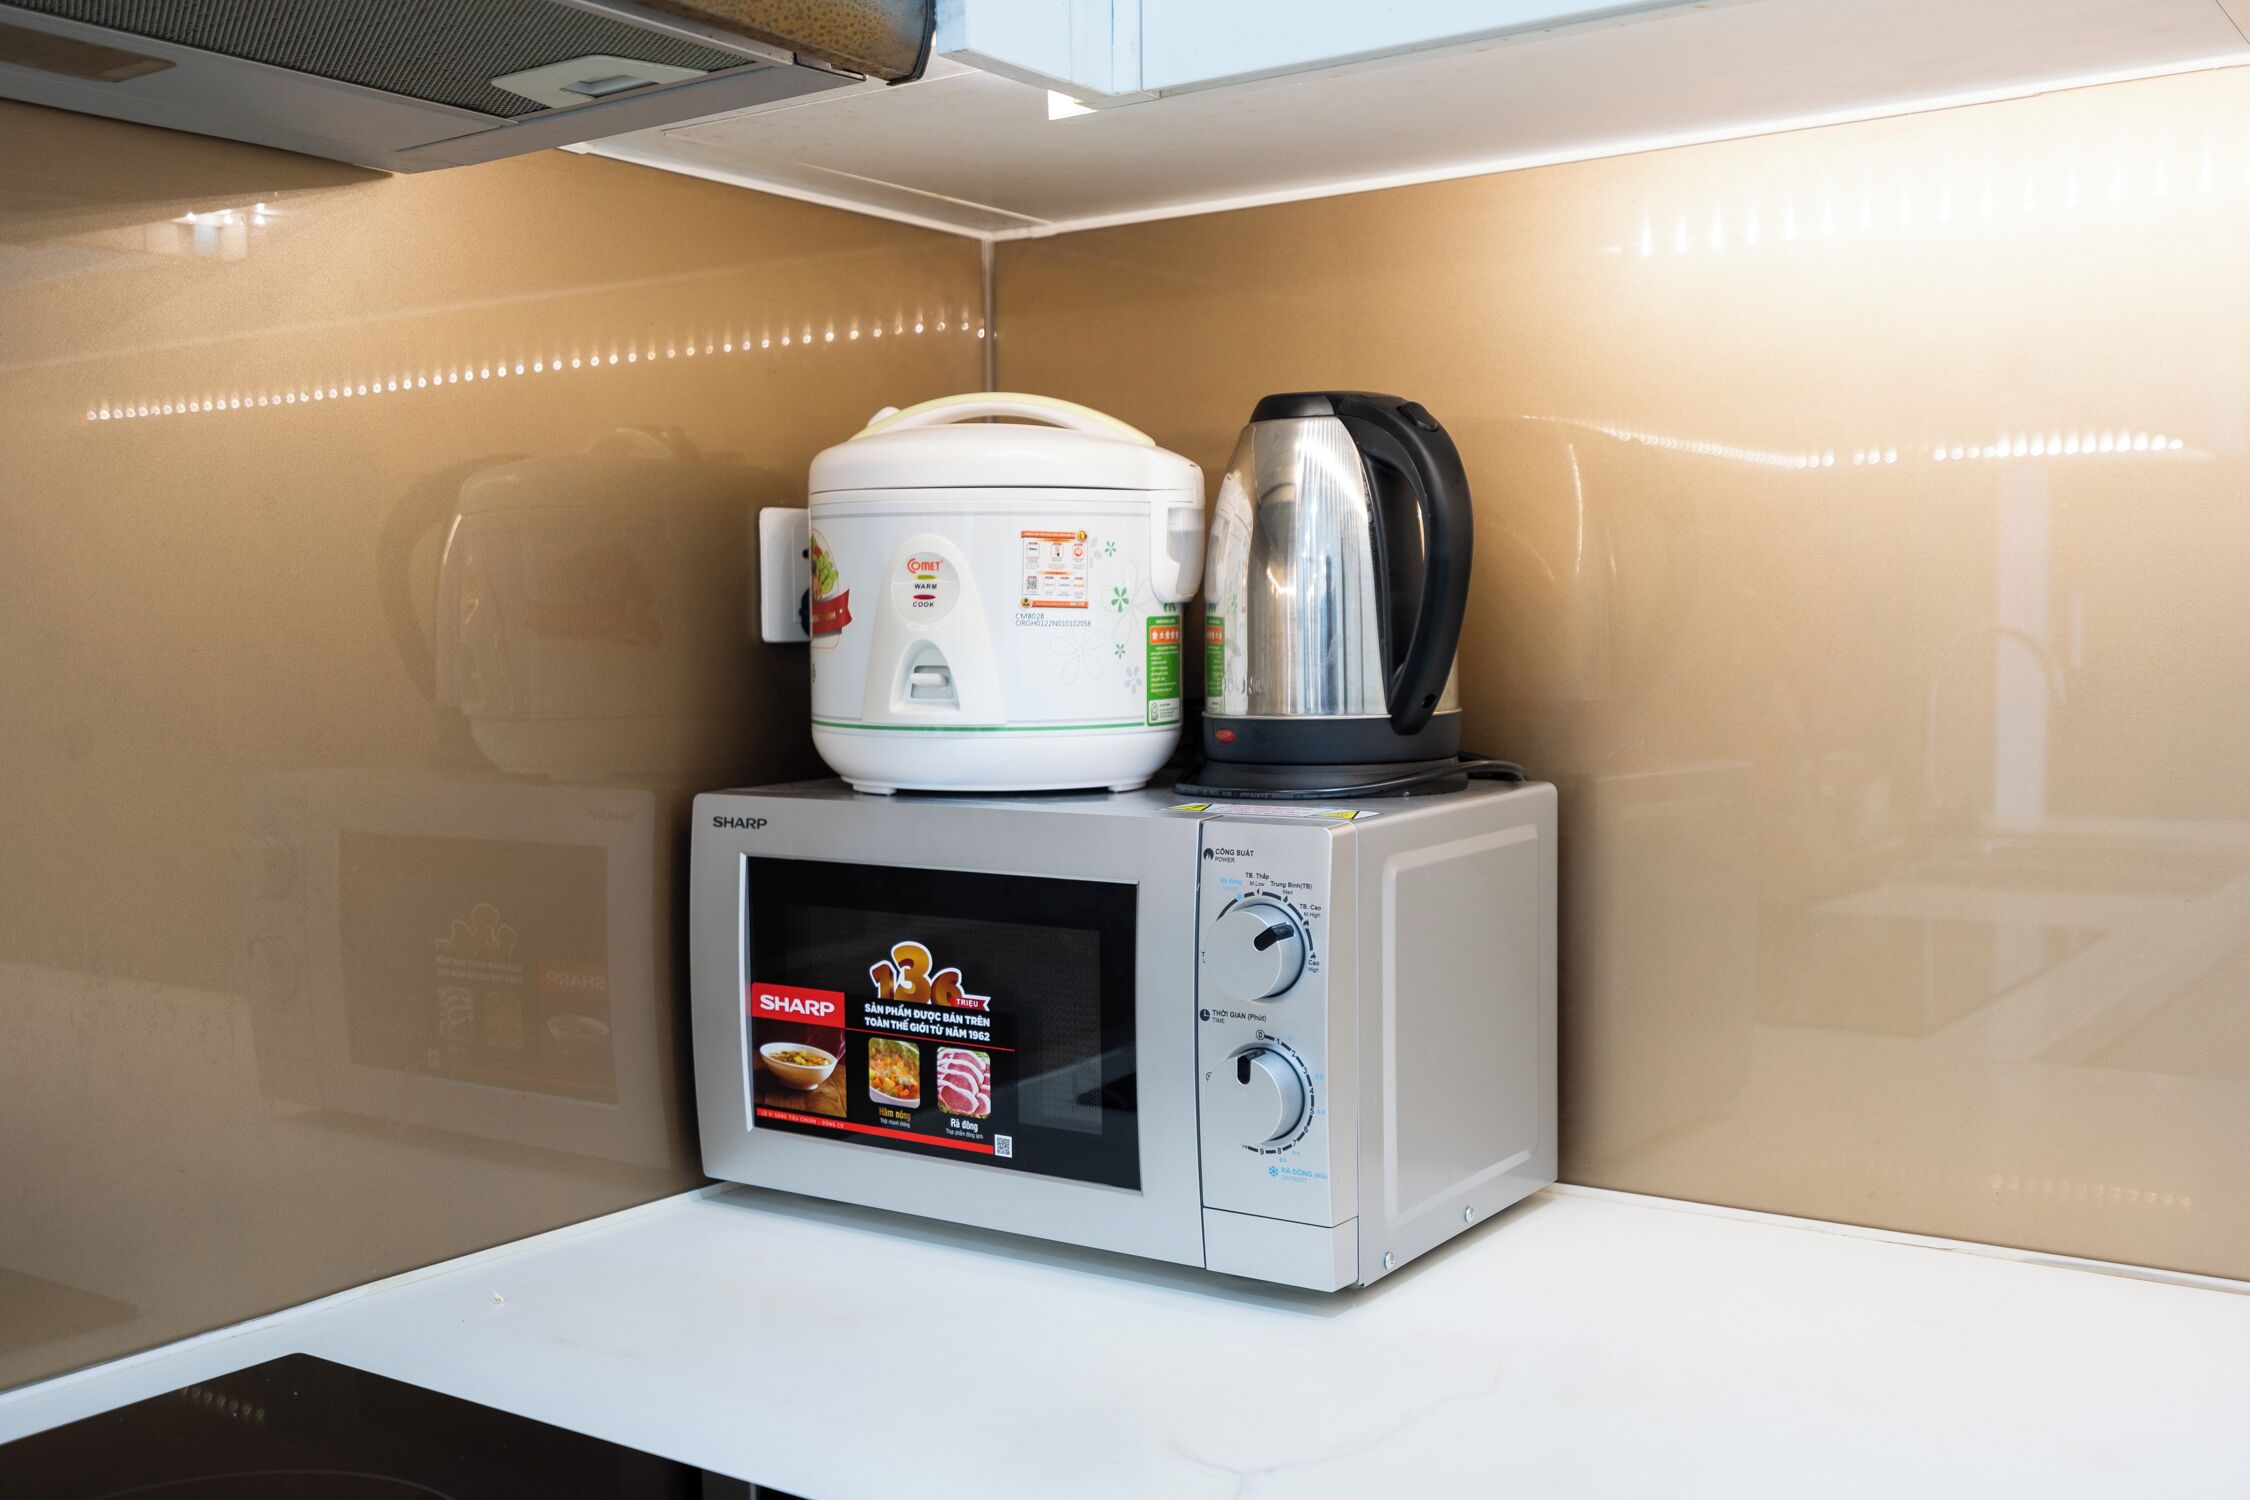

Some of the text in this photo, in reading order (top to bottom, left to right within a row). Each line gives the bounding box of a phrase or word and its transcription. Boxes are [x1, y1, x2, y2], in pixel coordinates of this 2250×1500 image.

[1015, 612, 1045, 620] CM8028
[712, 816, 768, 830] SHARP
[1270, 880, 1287, 888] Trung
[869, 940, 964, 1007] 136
[760, 994, 835, 1017] SHARP
[942, 1011, 964, 1024] BÁN
[964, 1014, 991, 1027] TRÊN
[1229, 1010, 1247, 1019] GIAN
[945, 1026, 967, 1039] NĂM
[968, 1030, 991, 1041] 1962
